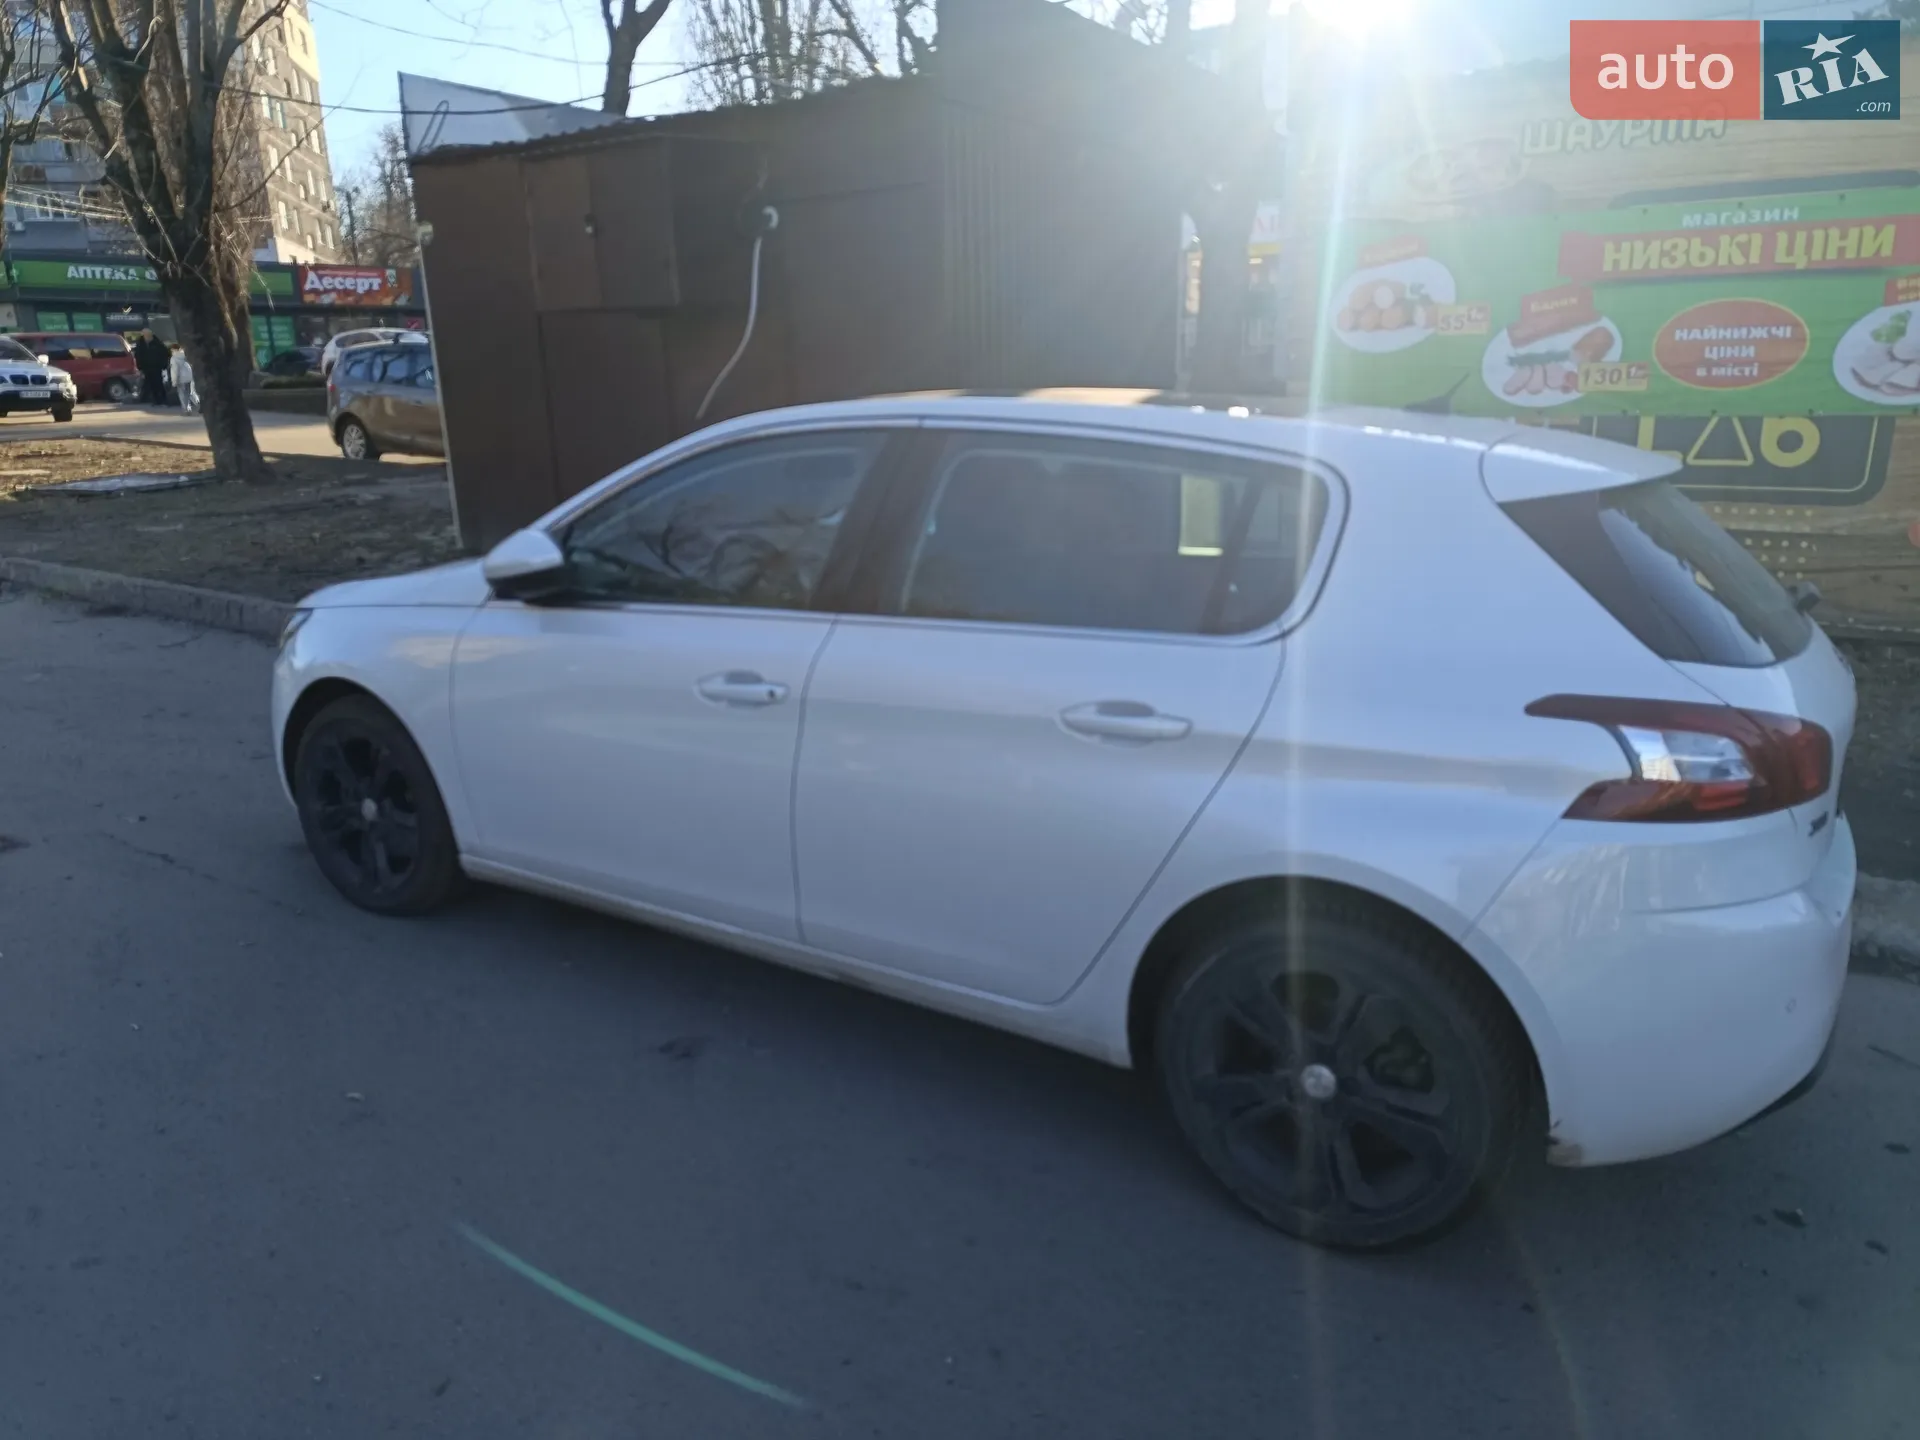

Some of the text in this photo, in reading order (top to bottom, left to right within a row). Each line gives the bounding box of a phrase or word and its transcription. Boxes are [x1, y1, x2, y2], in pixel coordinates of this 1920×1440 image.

[1682, 206, 1800, 229] магазин
[1602, 222, 1897, 272] НИЗЬКІ ЦІНИ
[67, 265, 139, 281] АПТЕКА
[303, 270, 383, 294] Десерт
[1674, 324, 1793, 341] НАЙНИЖЧІ
[1704, 345, 1756, 360] ЦІНИ
[1584, 367, 1622, 386] 130
